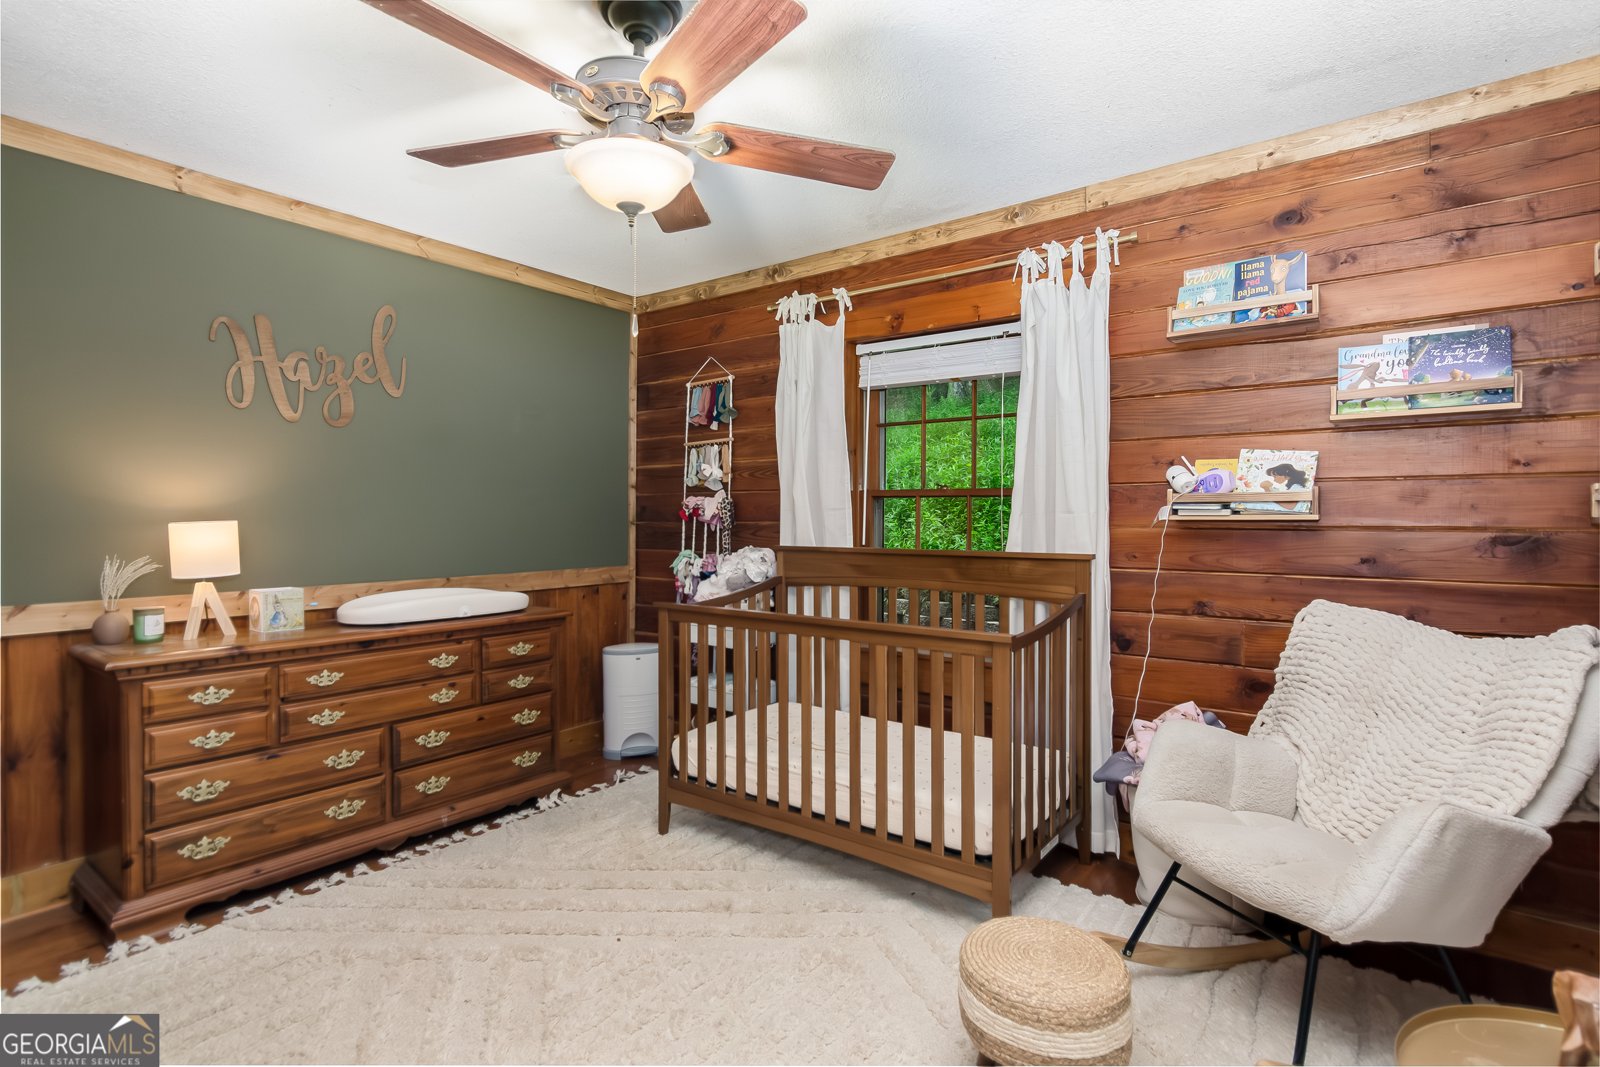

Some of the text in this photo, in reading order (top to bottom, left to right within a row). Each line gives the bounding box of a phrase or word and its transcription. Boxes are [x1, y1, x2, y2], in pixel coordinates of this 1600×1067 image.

[1241, 261, 1265, 271] llama
[1241, 269, 1265, 280] llama
[1245, 277, 1260, 287] red
[1237, 285, 1269, 300] pajama
[1344, 347, 1391, 364] Grandma
[208, 304, 407, 428] Hazel
